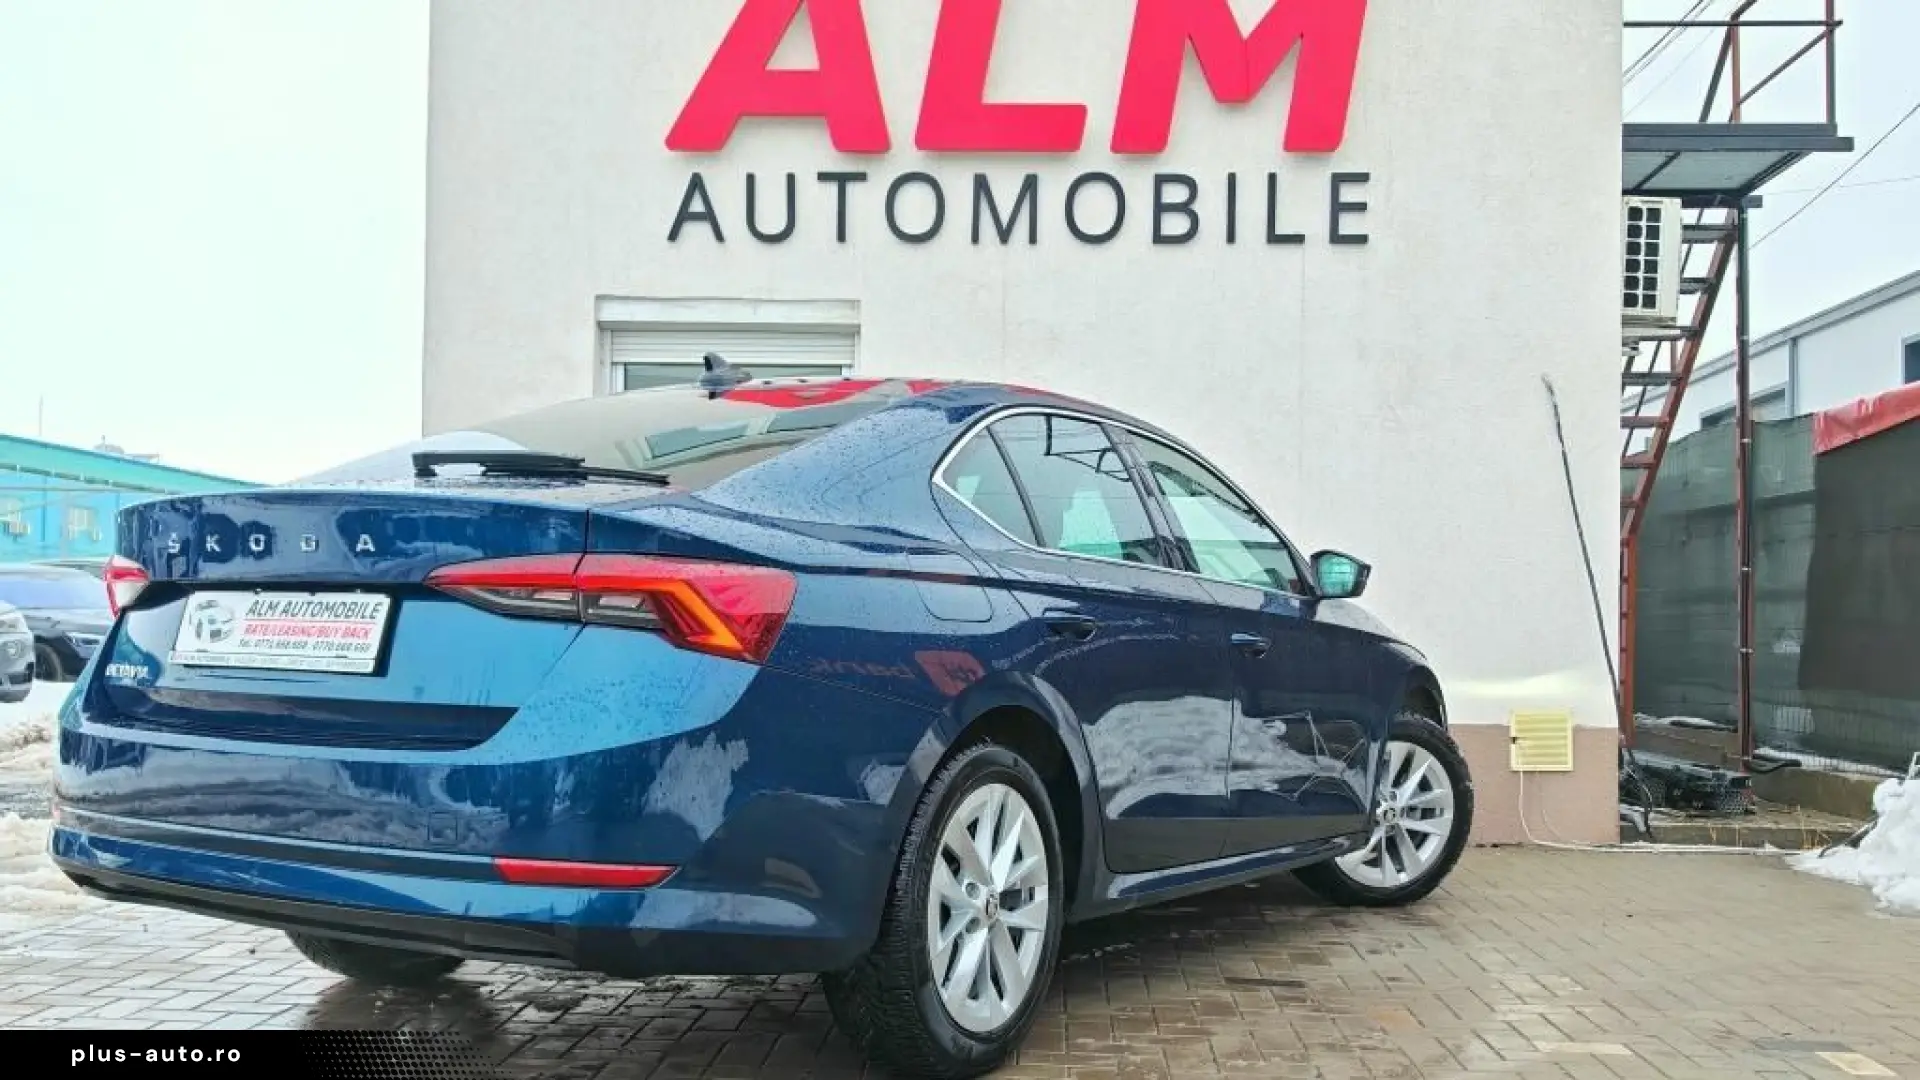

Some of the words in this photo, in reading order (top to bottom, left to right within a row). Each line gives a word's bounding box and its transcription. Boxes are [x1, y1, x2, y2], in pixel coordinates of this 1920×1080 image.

[664, 0, 1368, 154] ALM
[666, 171, 1371, 246] AUTOMOBILE
[245, 599, 281, 616] ALM
[279, 600, 384, 620] AUTOMOBILE
[341, 627, 373, 641] BACK
